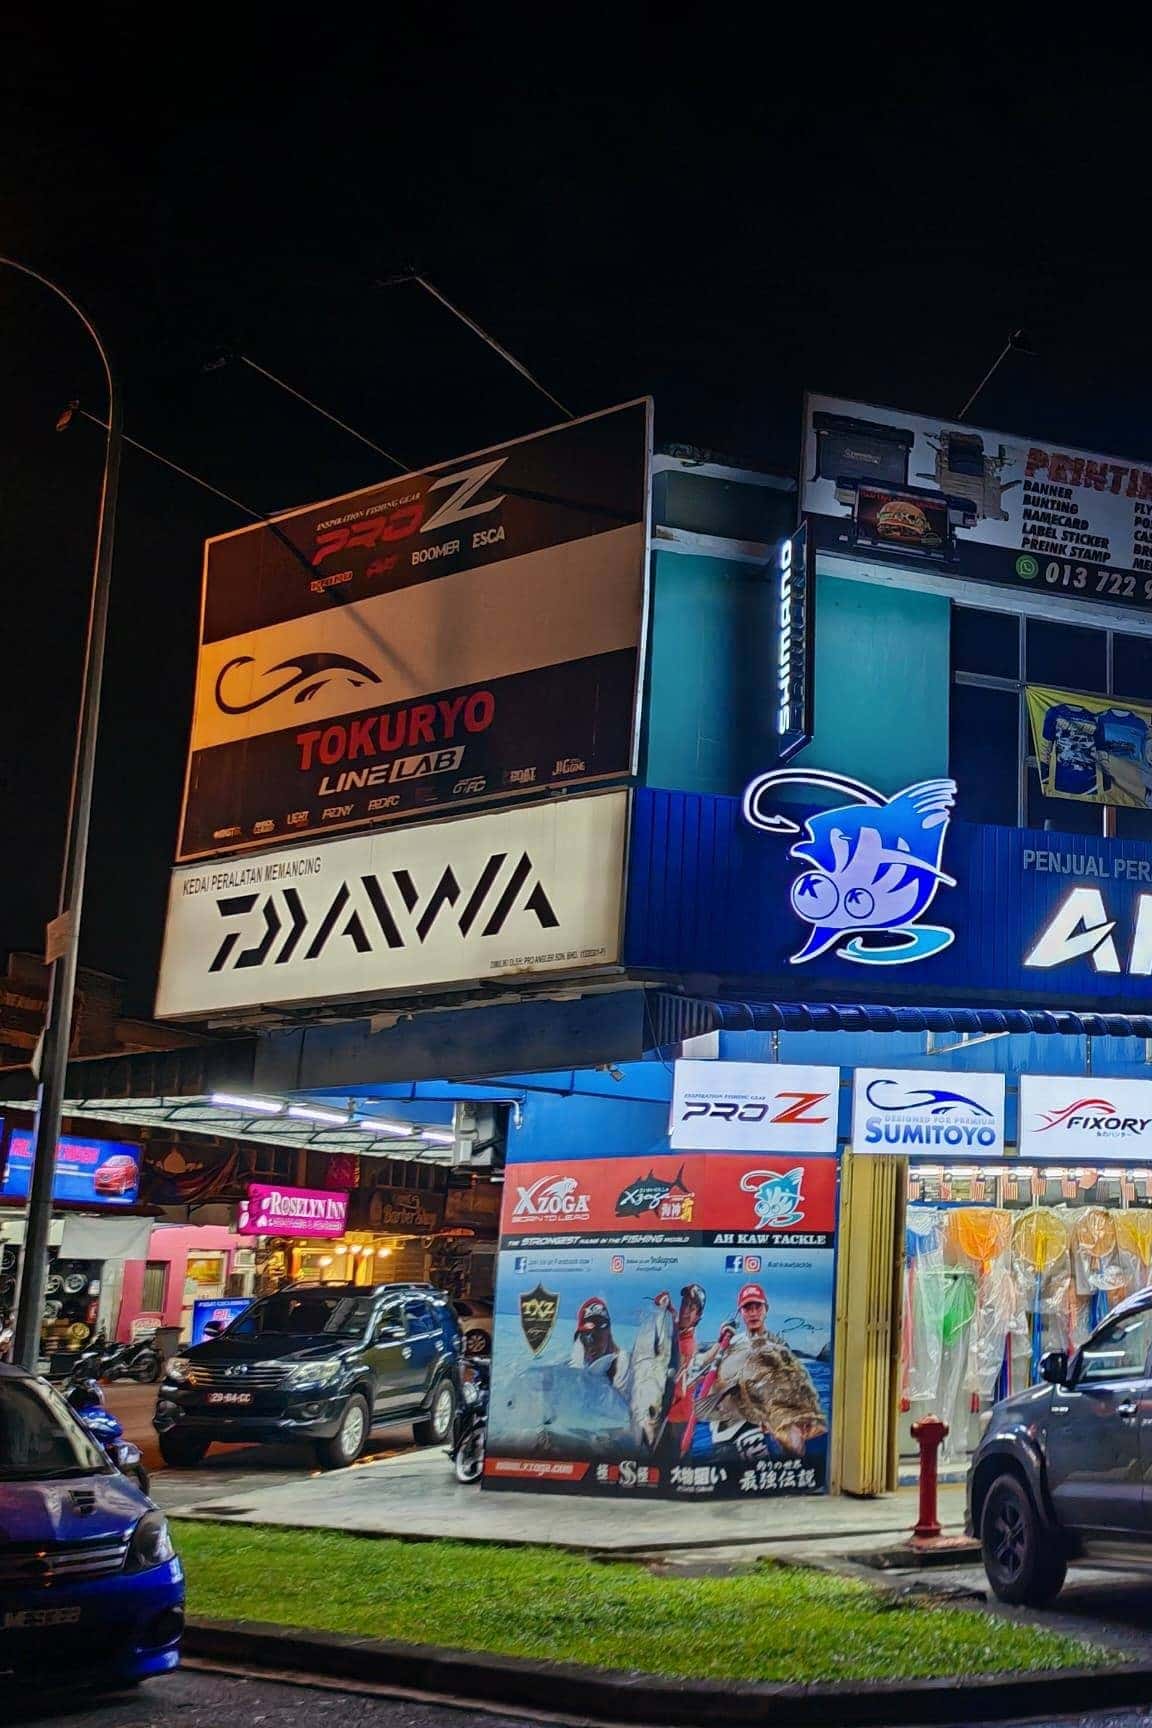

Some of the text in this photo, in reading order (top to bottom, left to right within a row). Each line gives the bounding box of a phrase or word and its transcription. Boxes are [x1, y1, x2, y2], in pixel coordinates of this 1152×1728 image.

[1022, 494, 1079, 515] BUNTING
[1023, 480, 1073, 500] BANNER
[1022, 509, 1089, 531] NAMECARD
[411, 539, 461, 567] BOOMER
[472, 526, 506, 549] ESCA
[1021, 537, 1111, 563] PREINK STAMP
[1022, 523, 1109, 549] LABEL STICKER
[1045, 561, 1088, 589] 013
[1096, 571, 1137, 597] 722
[777, 539, 792, 735] SHIMANO
[297, 691, 495, 769] TOKURYO
[183, 857, 321, 896] KEDAI PERALATAN MEMANCING
[1023, 849, 1110, 878] PENJUAL
[208, 850, 560, 973] DAIWA
[865, 1116, 996, 1147] SUMITOYO
[1067, 1116, 1152, 1135] FIXORY
[513, 1184, 591, 1215] XZOGA
[520, 1235, 581, 1247] STRONGEST
[621, 1234, 665, 1244] FISHING
[713, 1233, 827, 1245] AH KAW TACKLE
